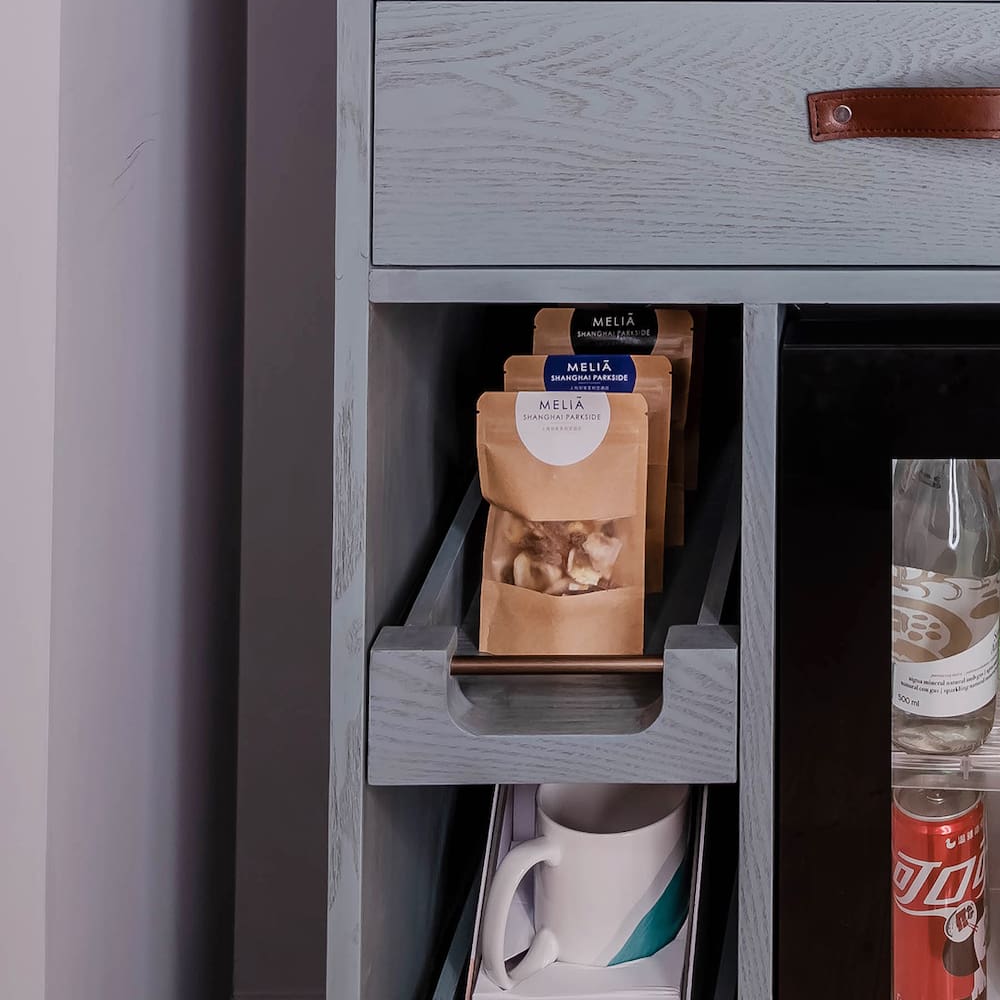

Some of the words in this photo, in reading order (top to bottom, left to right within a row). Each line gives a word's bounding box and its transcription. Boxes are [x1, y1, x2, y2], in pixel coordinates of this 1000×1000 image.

[577, 329, 616, 338] SHANGHAI
[617, 328, 651, 338] PARKSIDE
[550, 374, 592, 382] SHANGHAI
[592, 374, 629, 382] PARKSIDE
[523, 413, 565, 421] SHANGHAI
[565, 413, 601, 421] PARKSIDE
[945, 677, 966, 686] natural
[897, 693, 911, 705] 500
[911, 699, 920, 707] ml
